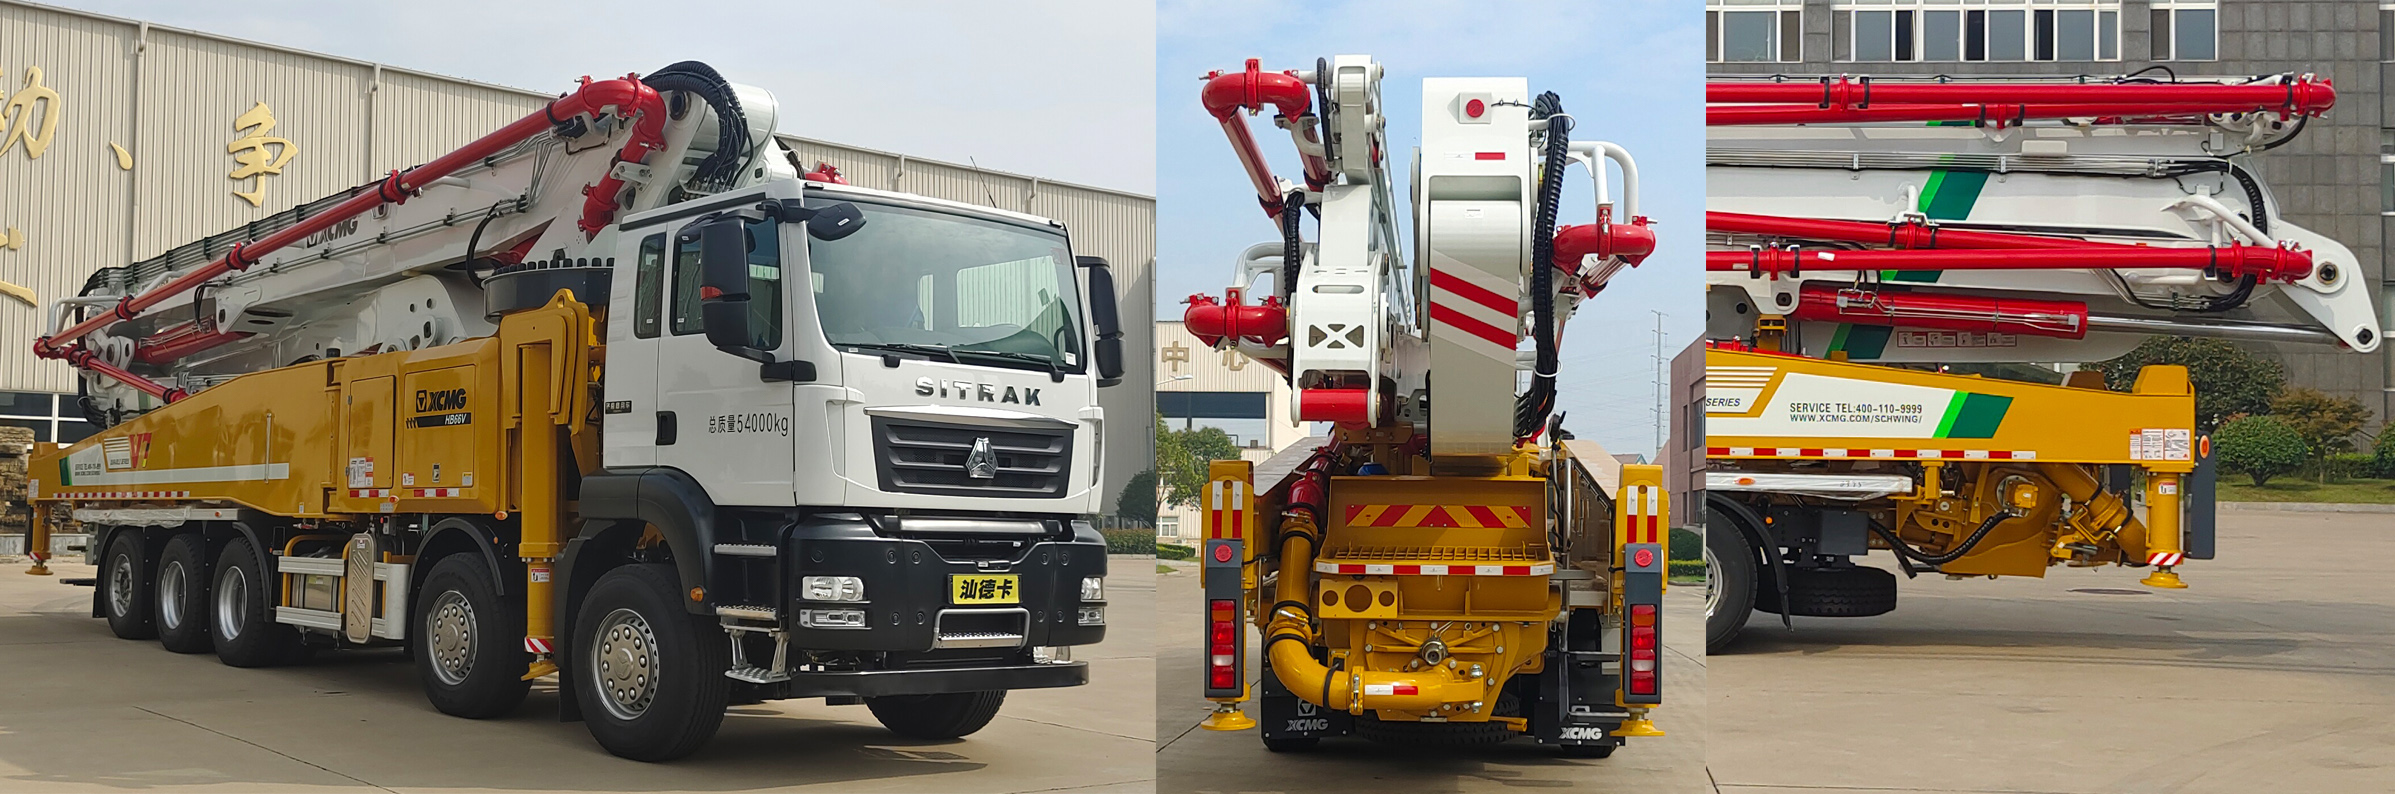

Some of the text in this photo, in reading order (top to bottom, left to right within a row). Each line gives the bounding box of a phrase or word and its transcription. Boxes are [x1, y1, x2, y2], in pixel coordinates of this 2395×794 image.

[915, 376, 1041, 406] SITRAK
[427, 388, 467, 412] XCMG
[1706, 398, 1741, 407] SERIES
[1790, 403, 1831, 413] SERVICE
[444, 413, 467, 425] HB66V
[708, 412, 789, 437] 总质量54000kg
[1790, 414, 1922, 423] WWW.XCMG.COM/SCHWING/
[959, 579, 1013, 599] 汕德卡
[1285, 718, 1329, 731] XCMG
[1559, 727, 1603, 740] XCMG
